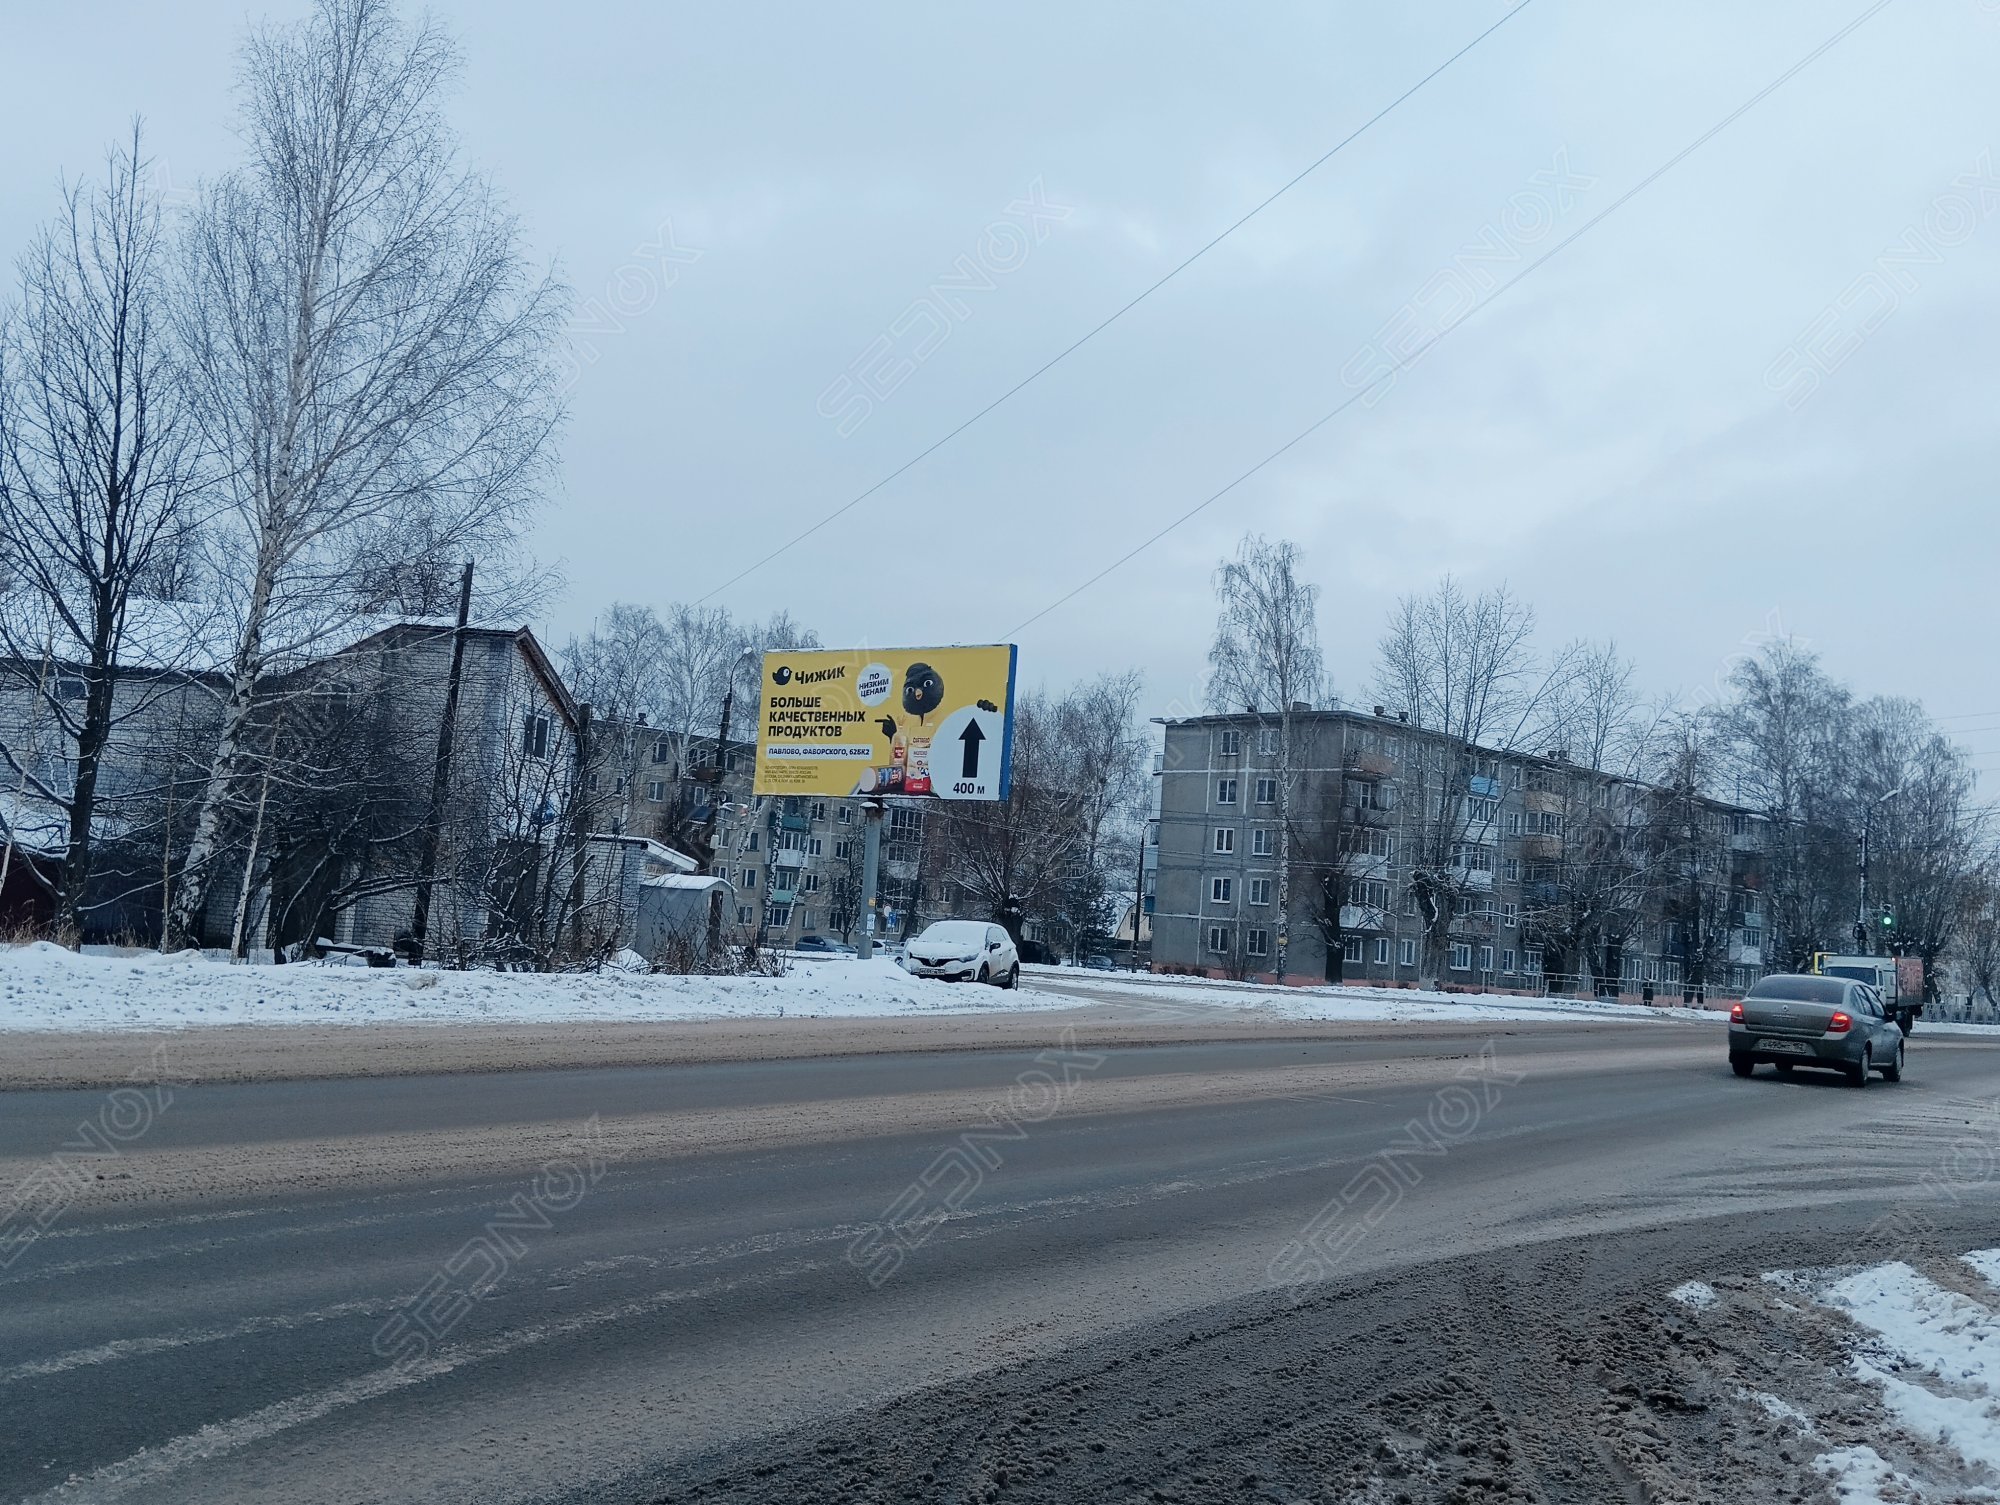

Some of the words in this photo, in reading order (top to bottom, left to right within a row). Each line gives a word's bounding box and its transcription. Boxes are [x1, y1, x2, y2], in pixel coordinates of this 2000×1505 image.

[869, 672, 880, 681] ПО
[858, 678, 889, 691] НИЗКИМ
[860, 686, 887, 698] ЦЕНАМ
[770, 697, 821, 708] БОЛЬШЕ
[769, 711, 866, 723] КАЧЕСТВЕННЫХ
[768, 725, 843, 739] ПРОДУКТОВ
[768, 748, 802, 756] ПАВЛОВО,
[802, 748, 848, 757] ФАВОРСКОГО,
[952, 782, 975, 794] 400
